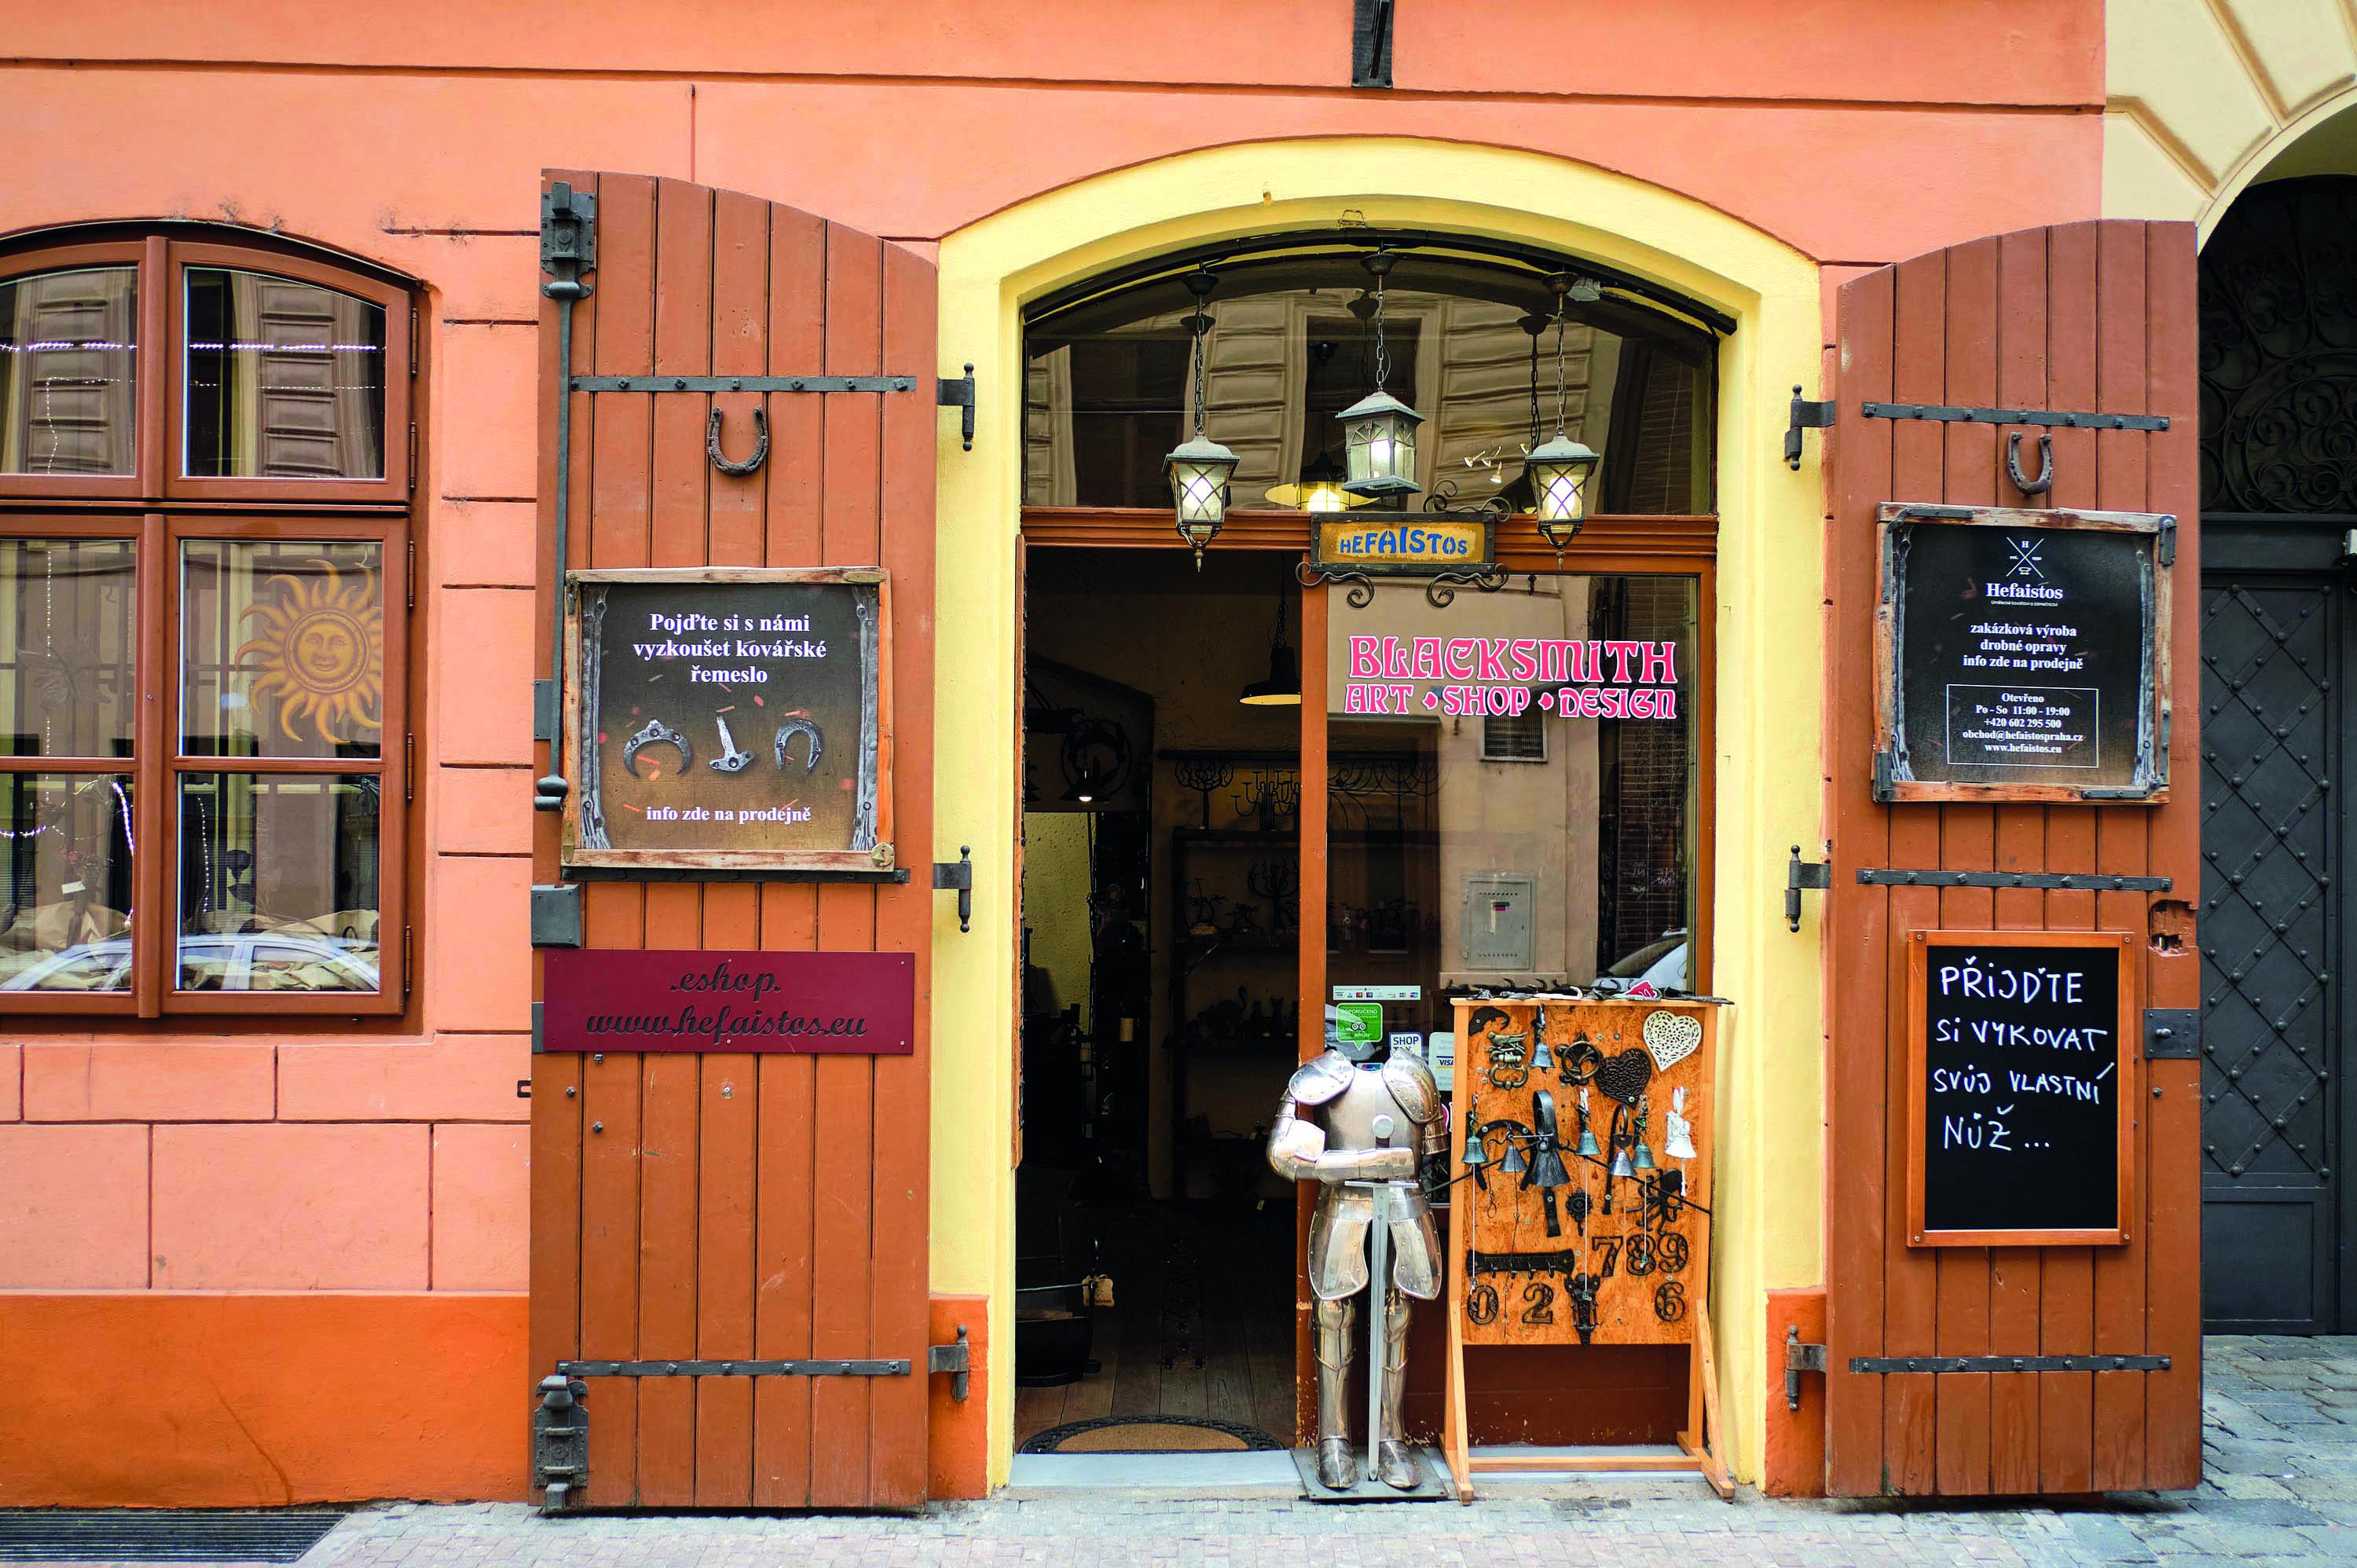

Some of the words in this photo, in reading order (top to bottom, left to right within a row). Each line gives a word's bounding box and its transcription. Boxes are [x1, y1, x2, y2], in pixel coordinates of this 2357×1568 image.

[1341, 528, 1466, 553] HEFAISTOS
[1986, 583, 2063, 599] Hefaistos
[651, 614, 717, 633] Pojďte
[724, 614, 739, 630] si
[745, 619, 753, 631] s
[761, 614, 809, 631] námi
[1970, 622, 2033, 636] zakázková
[2036, 625, 2078, 639] výroba
[633, 639, 731, 661] vyzkoušet
[736, 640, 826, 658] kovářské
[1979, 639, 2024, 651] drobné
[2025, 641, 2067, 655] opravy
[1351, 636, 1677, 683] BLACKSMITH
[1963, 654, 1987, 667] info
[1989, 655, 2010, 668] zde
[2013, 658, 2028, 668] na
[2030, 658, 2084, 671] prodejně
[691, 665, 767, 683] řemeslo
[1345, 684, 1413, 714] ART
[1443, 686, 1530, 716] SHOP
[1559, 688, 1675, 718] DESIGN
[2001, 692, 2045, 703] Otevřeno
[1975, 704, 1989, 715] Po
[1996, 705, 2008, 715] So
[2013, 705, 2037, 716] 11:00
[2046, 706, 2070, 716] 19:00
[1984, 717, 2007, 727] +420
[2008, 718, 2026, 727] 602
[2027, 719, 2044, 728] 295
[2044, 719, 2062, 729] 500
[1963, 730, 2084, 742] obchod@hefaistospraha.cz
[1985, 743, 2062, 753] www.hefaistos.eu
[647, 807, 677, 820] info
[682, 807, 709, 820] zde
[715, 811, 734, 820] na
[739, 808, 811, 824] prodejně
[586, 1006, 867, 1044] www.hefaistos.eu
[1393, 1036, 1419, 1046] SHOP
[1971, 1020, 2107, 1051] VYKOVAT
[2010, 1062, 2114, 1106] VLASTNÍ
